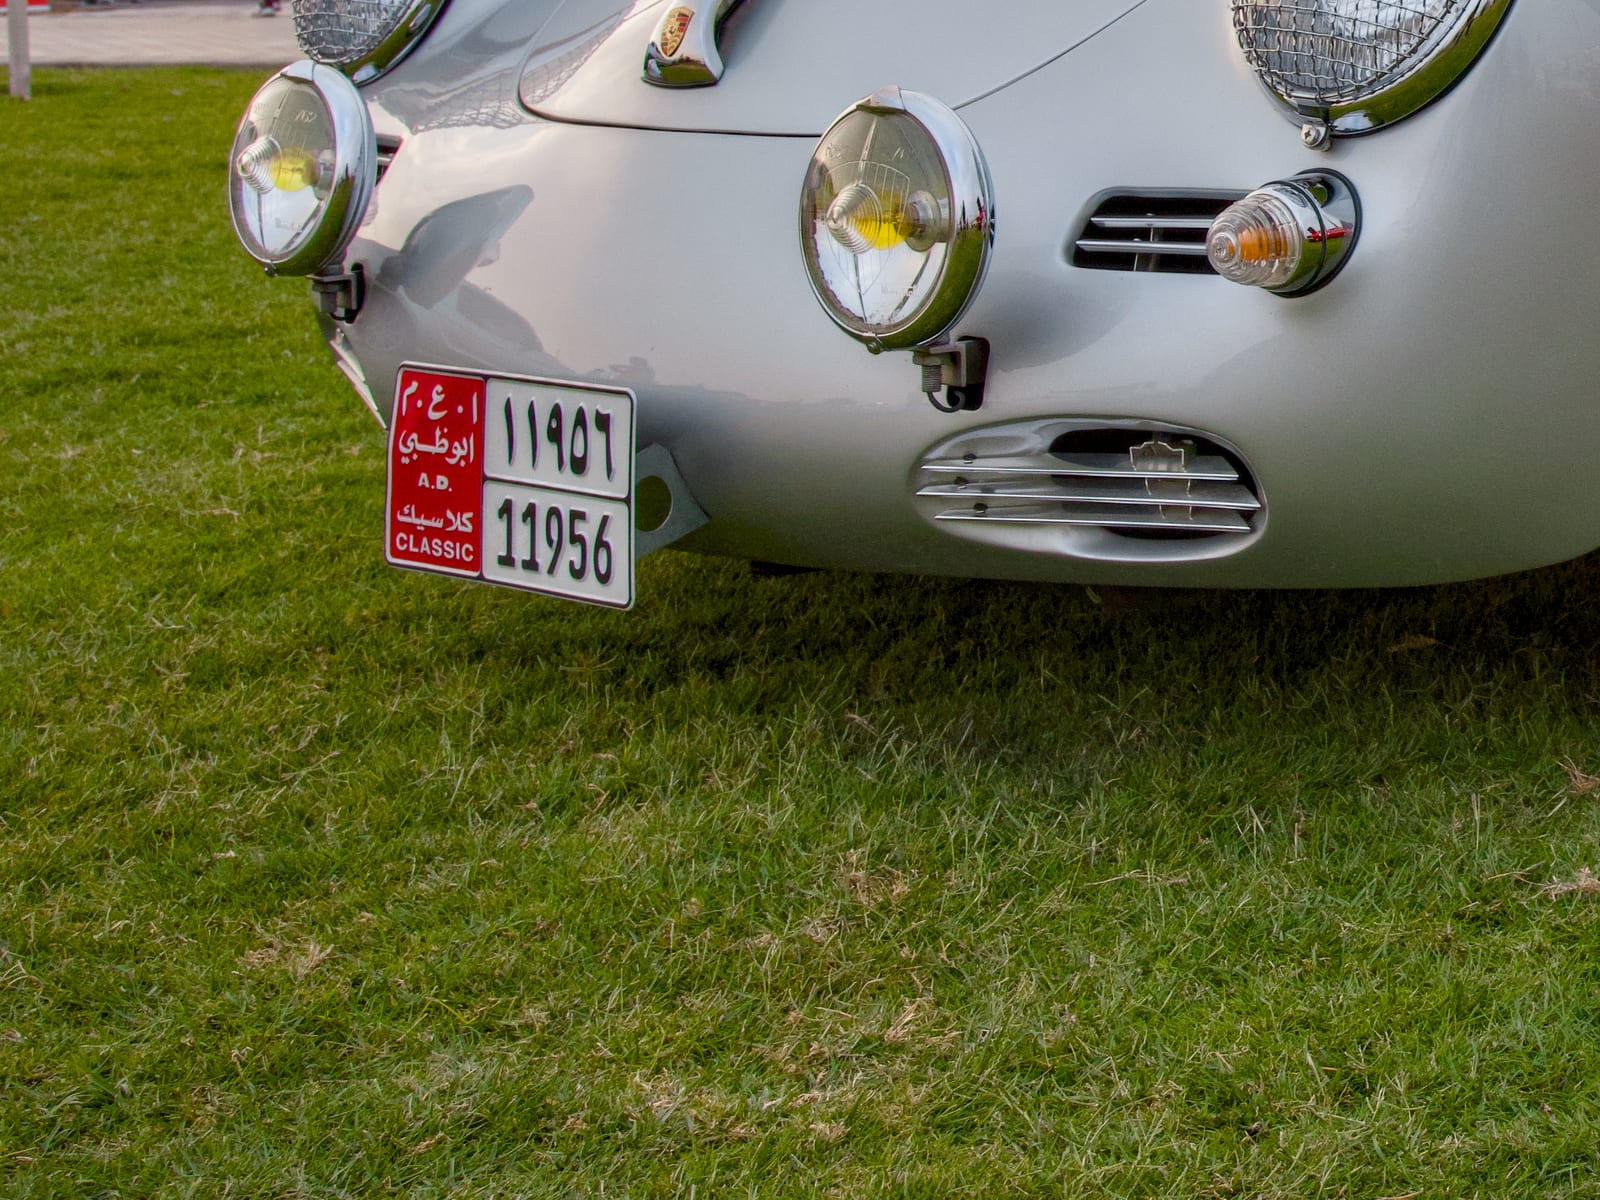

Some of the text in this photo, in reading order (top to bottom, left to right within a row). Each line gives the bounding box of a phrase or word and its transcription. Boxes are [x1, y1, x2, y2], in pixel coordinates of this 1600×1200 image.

[504, 392, 614, 482] ١١٩٥٦
[417, 472, 454, 493] A.D.
[396, 503, 474, 534] كلاسيك
[395, 532, 474, 563] CLASSIC
[497, 495, 613, 585] 11956
